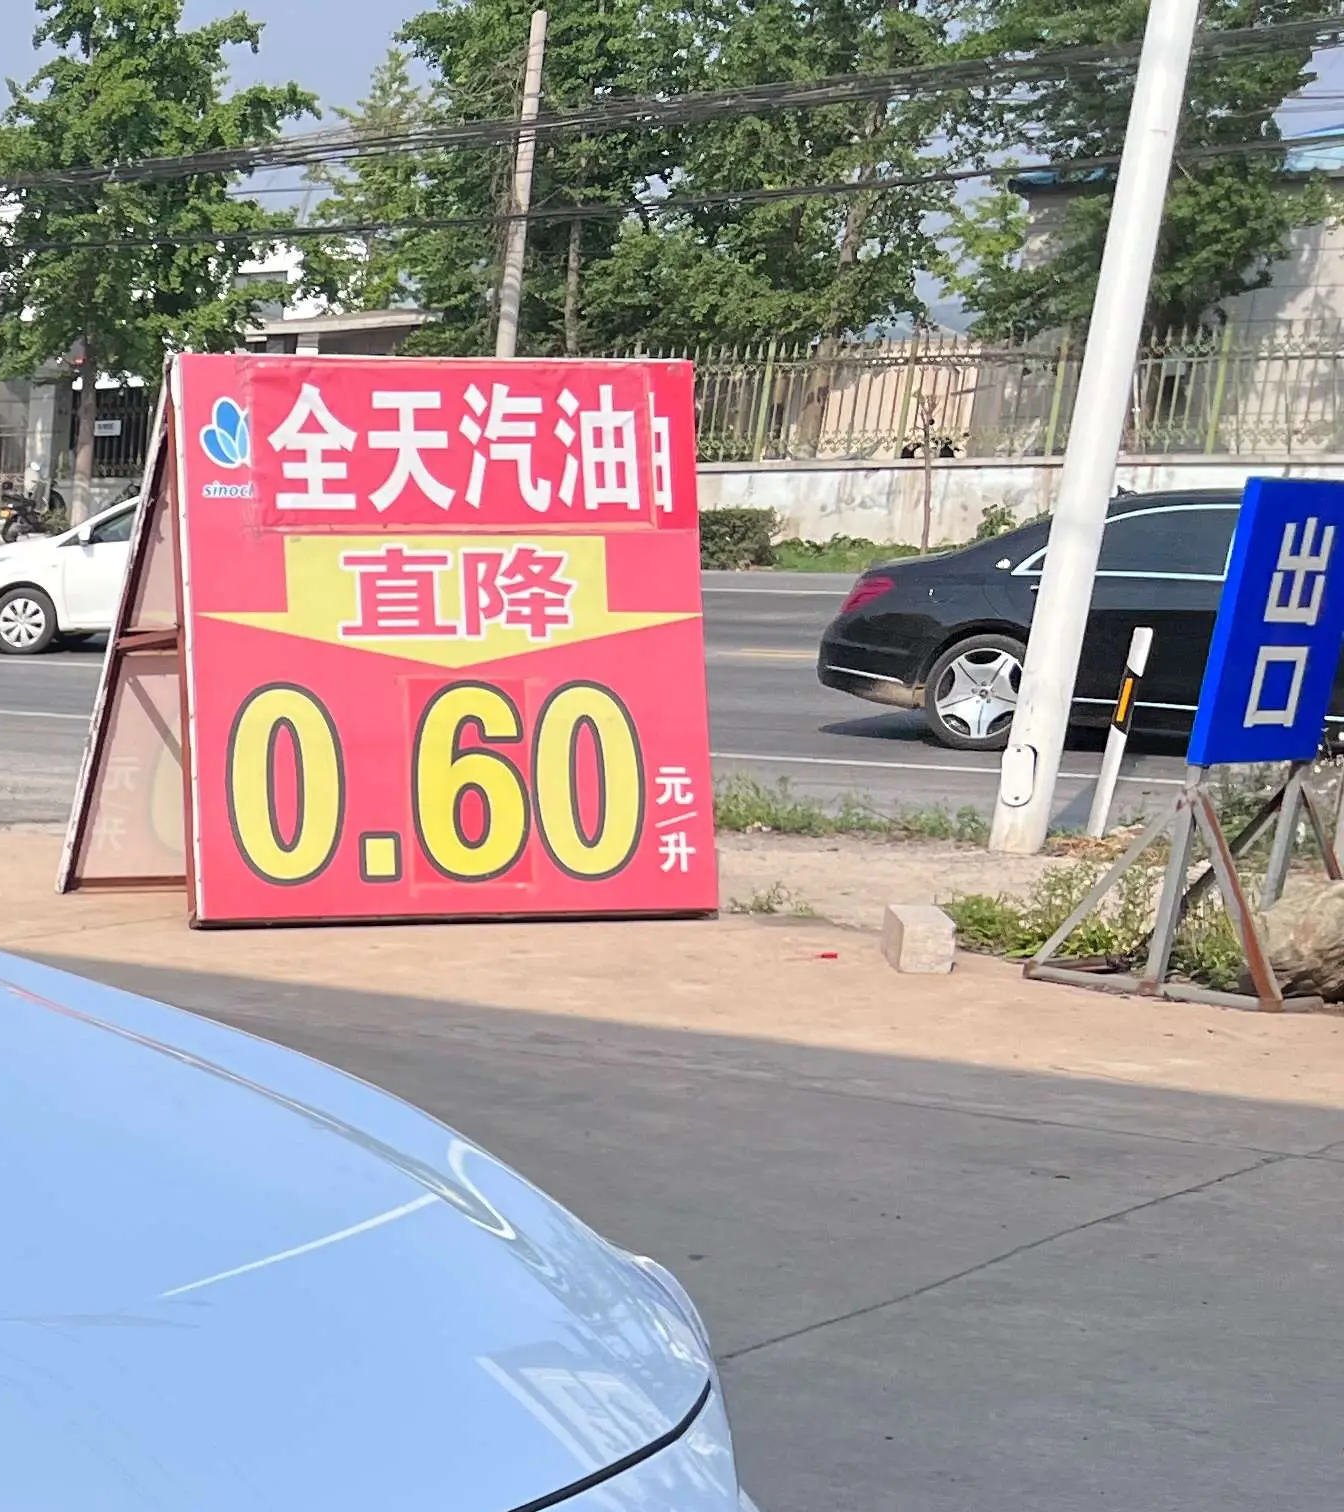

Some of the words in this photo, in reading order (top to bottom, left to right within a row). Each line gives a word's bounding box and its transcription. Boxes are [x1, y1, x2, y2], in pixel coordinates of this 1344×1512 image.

[268, 383, 641, 512] 全天汽油
[338, 544, 578, 642] 直降
[1243, 517, 1336, 729] 出口
[229, 680, 645, 885] 0.60
